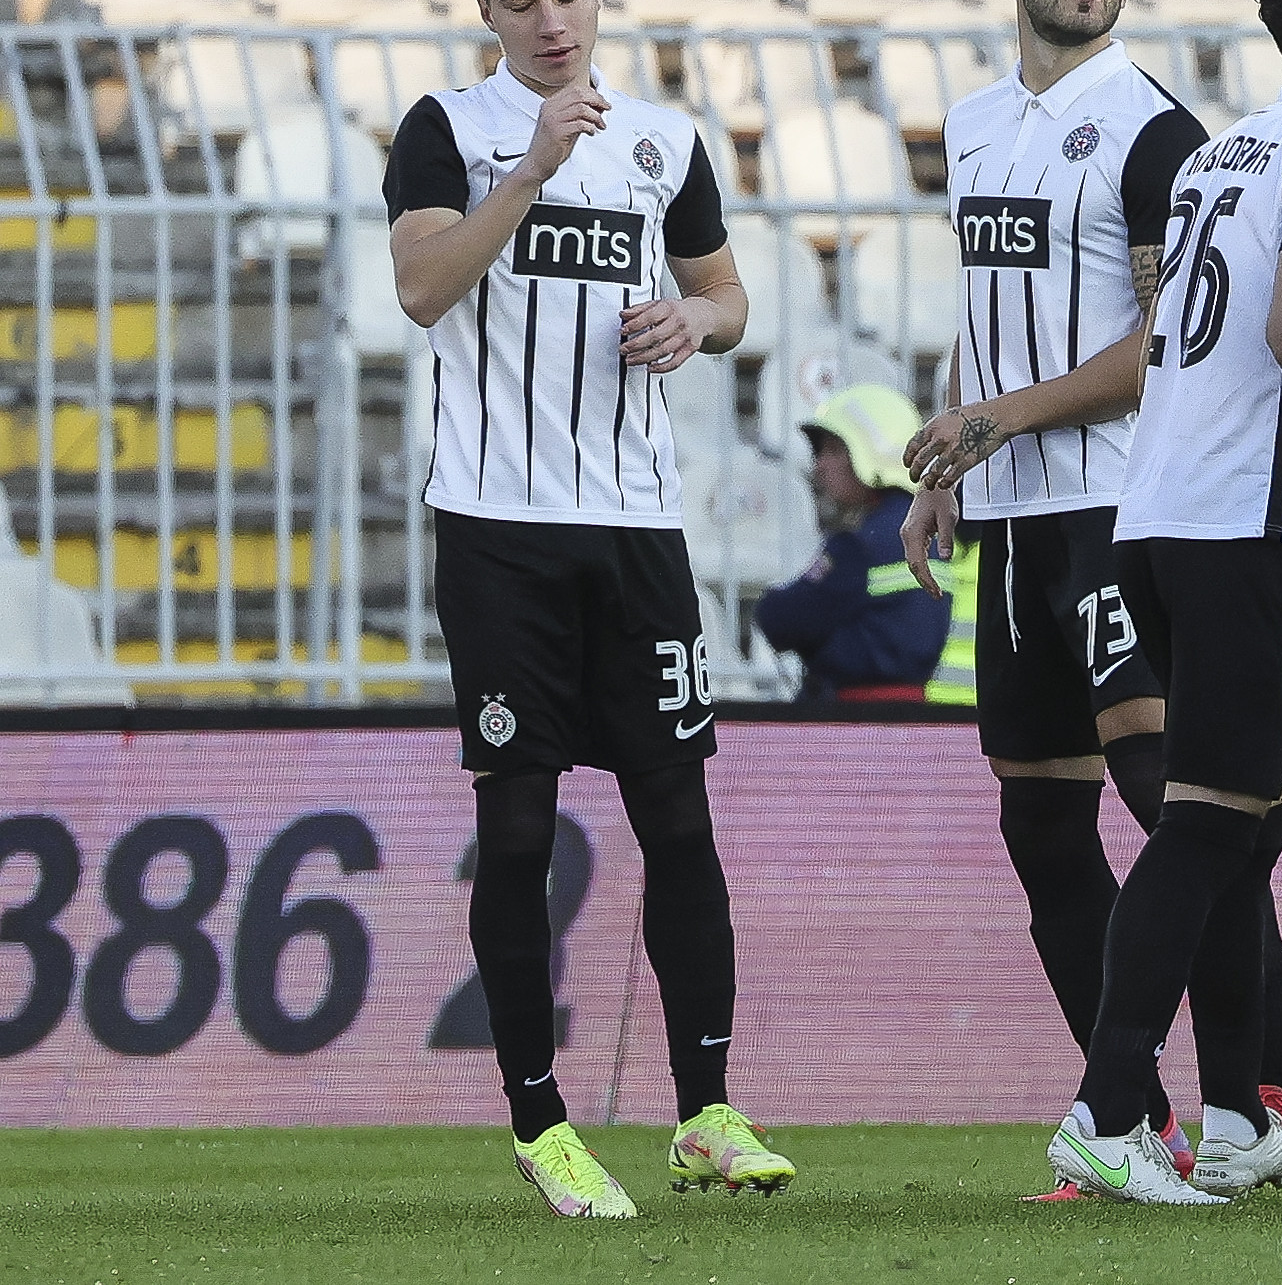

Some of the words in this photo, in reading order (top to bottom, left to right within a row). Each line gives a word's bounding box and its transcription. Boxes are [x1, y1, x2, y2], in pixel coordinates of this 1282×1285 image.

[527, 219, 632, 270] mts
[963, 208, 1036, 255] mts
[1149, 186, 1245, 369] 26
[1077, 586, 1136, 667] 13
[655, 635, 714, 712] 36
